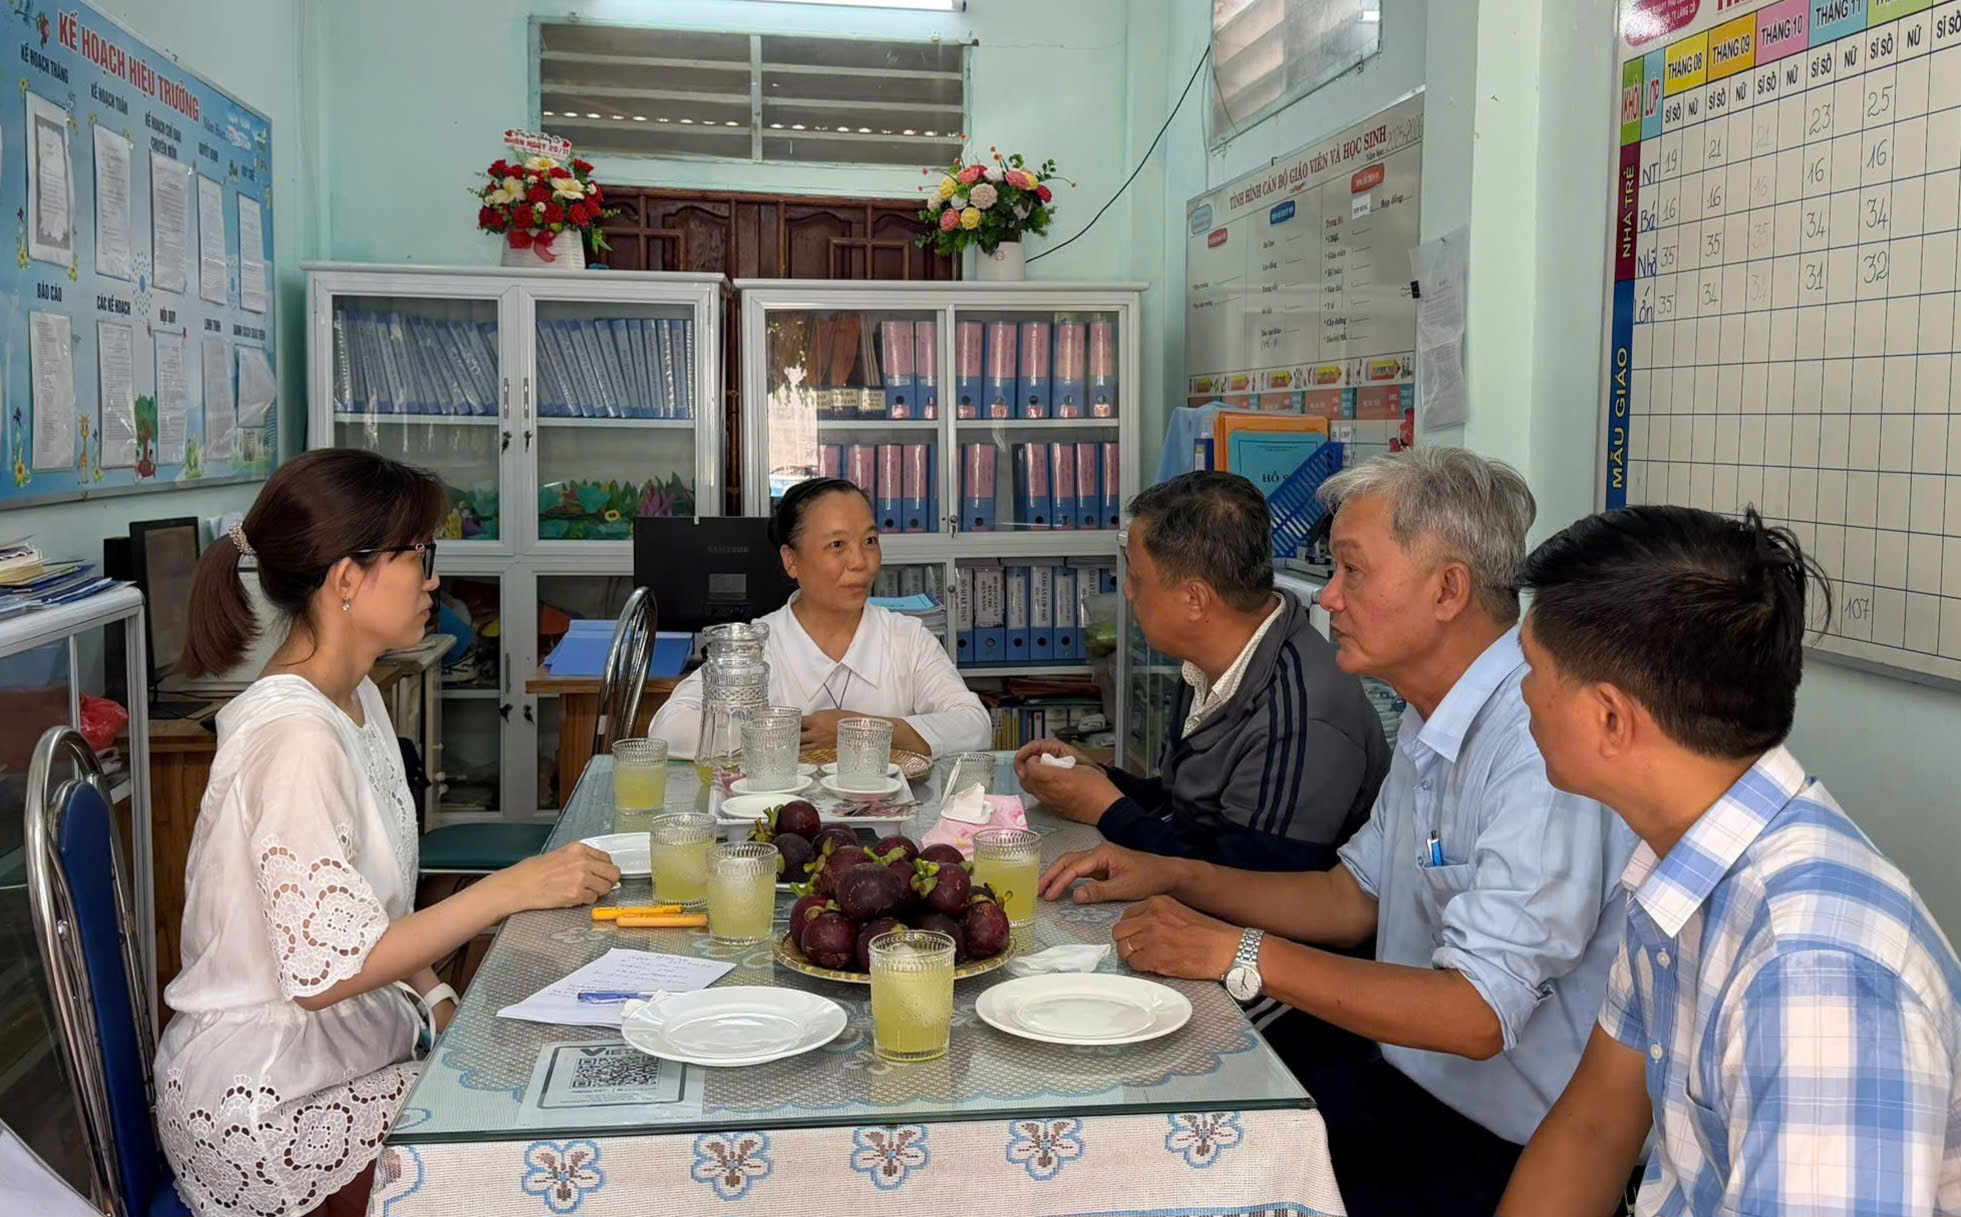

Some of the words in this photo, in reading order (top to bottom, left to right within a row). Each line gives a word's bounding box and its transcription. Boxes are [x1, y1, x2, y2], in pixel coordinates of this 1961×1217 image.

[1761, 20, 1790, 46] THÁNG
[1793, 15, 1803, 36] 10
[1907, 24, 1921, 48] NỮ
[1713, 39, 1738, 64] THÁNG
[1741, 35, 1750, 53] 09
[1844, 45, 1857, 69] NỮ
[58, 11, 78, 52] KẾ
[82, 26, 126, 80] HOẠCH
[129, 55, 156, 98] HIỆU
[158, 75, 200, 123] TRƯỞNG
[1668, 56, 1692, 80] THÁNG
[1693, 52, 1702, 72] 08
[1786, 64, 1798, 87] NỮ
[1645, 75, 1660, 117] LỚP
[1735, 80, 1747, 101] NỮ
[1867, 83, 1894, 118] 25
[1689, 97, 1698, 117] NỮ
[1809, 104, 1831, 136] 23
[1664, 148, 1678, 174] 19
[1708, 137, 1722, 160] 21
[1866, 138, 1888, 169] 16
[1230, 191, 1245, 210] TÌNH
[1245, 183, 1262, 206] HÌNH
[1263, 176, 1278, 199] CÁN
[1278, 169, 1288, 190] BỘ
[1289, 160, 1308, 184] GIÁO
[1310, 150, 1328, 175] VIÊN
[1329, 143, 1341, 165] VÀ
[1343, 137, 1361, 161] HỌC
[1364, 125, 1387, 150] SINH
[1642, 162, 1659, 186] NT
[1807, 157, 1825, 184] 16
[1662, 197, 1676, 222] 16
[1707, 185, 1721, 209] 16
[1806, 210, 1826, 239] 34
[1865, 197, 1889, 230] 34
[1660, 245, 1677, 267] 35
[1705, 231, 1722, 257] 35
[1805, 260, 1824, 291] 31
[1863, 250, 1889, 284] 32
[37, 281, 49, 301] BÁO
[50, 283, 62, 303] CÁO
[1657, 294, 1675, 315] 35
[1703, 280, 1719, 306] 34
[1615, 347, 1628, 418] GIÁO
[1610, 427, 1625, 489] MẪU
[1844, 597, 1870, 620] 107
